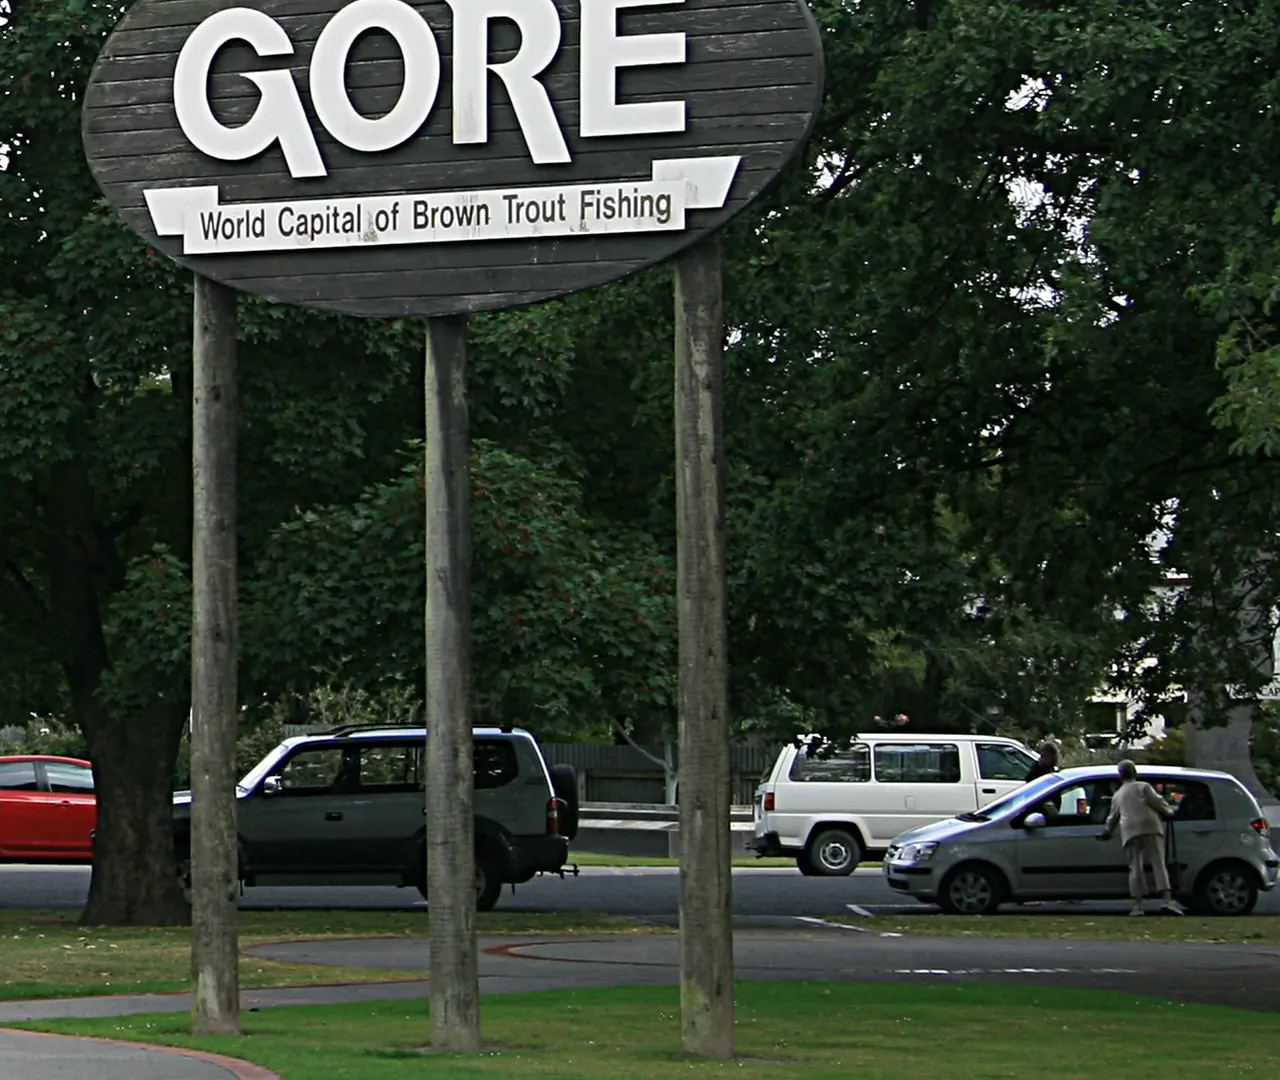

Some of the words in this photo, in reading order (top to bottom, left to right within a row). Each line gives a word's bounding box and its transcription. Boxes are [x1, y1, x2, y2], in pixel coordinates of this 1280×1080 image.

[200, 208, 265, 240] World
[278, 203, 361, 242] Capital
[375, 201, 400, 232] of
[413, 199, 490, 230] Brown
[502, 193, 567, 225] Trout
[580, 187, 672, 224] Fishing
